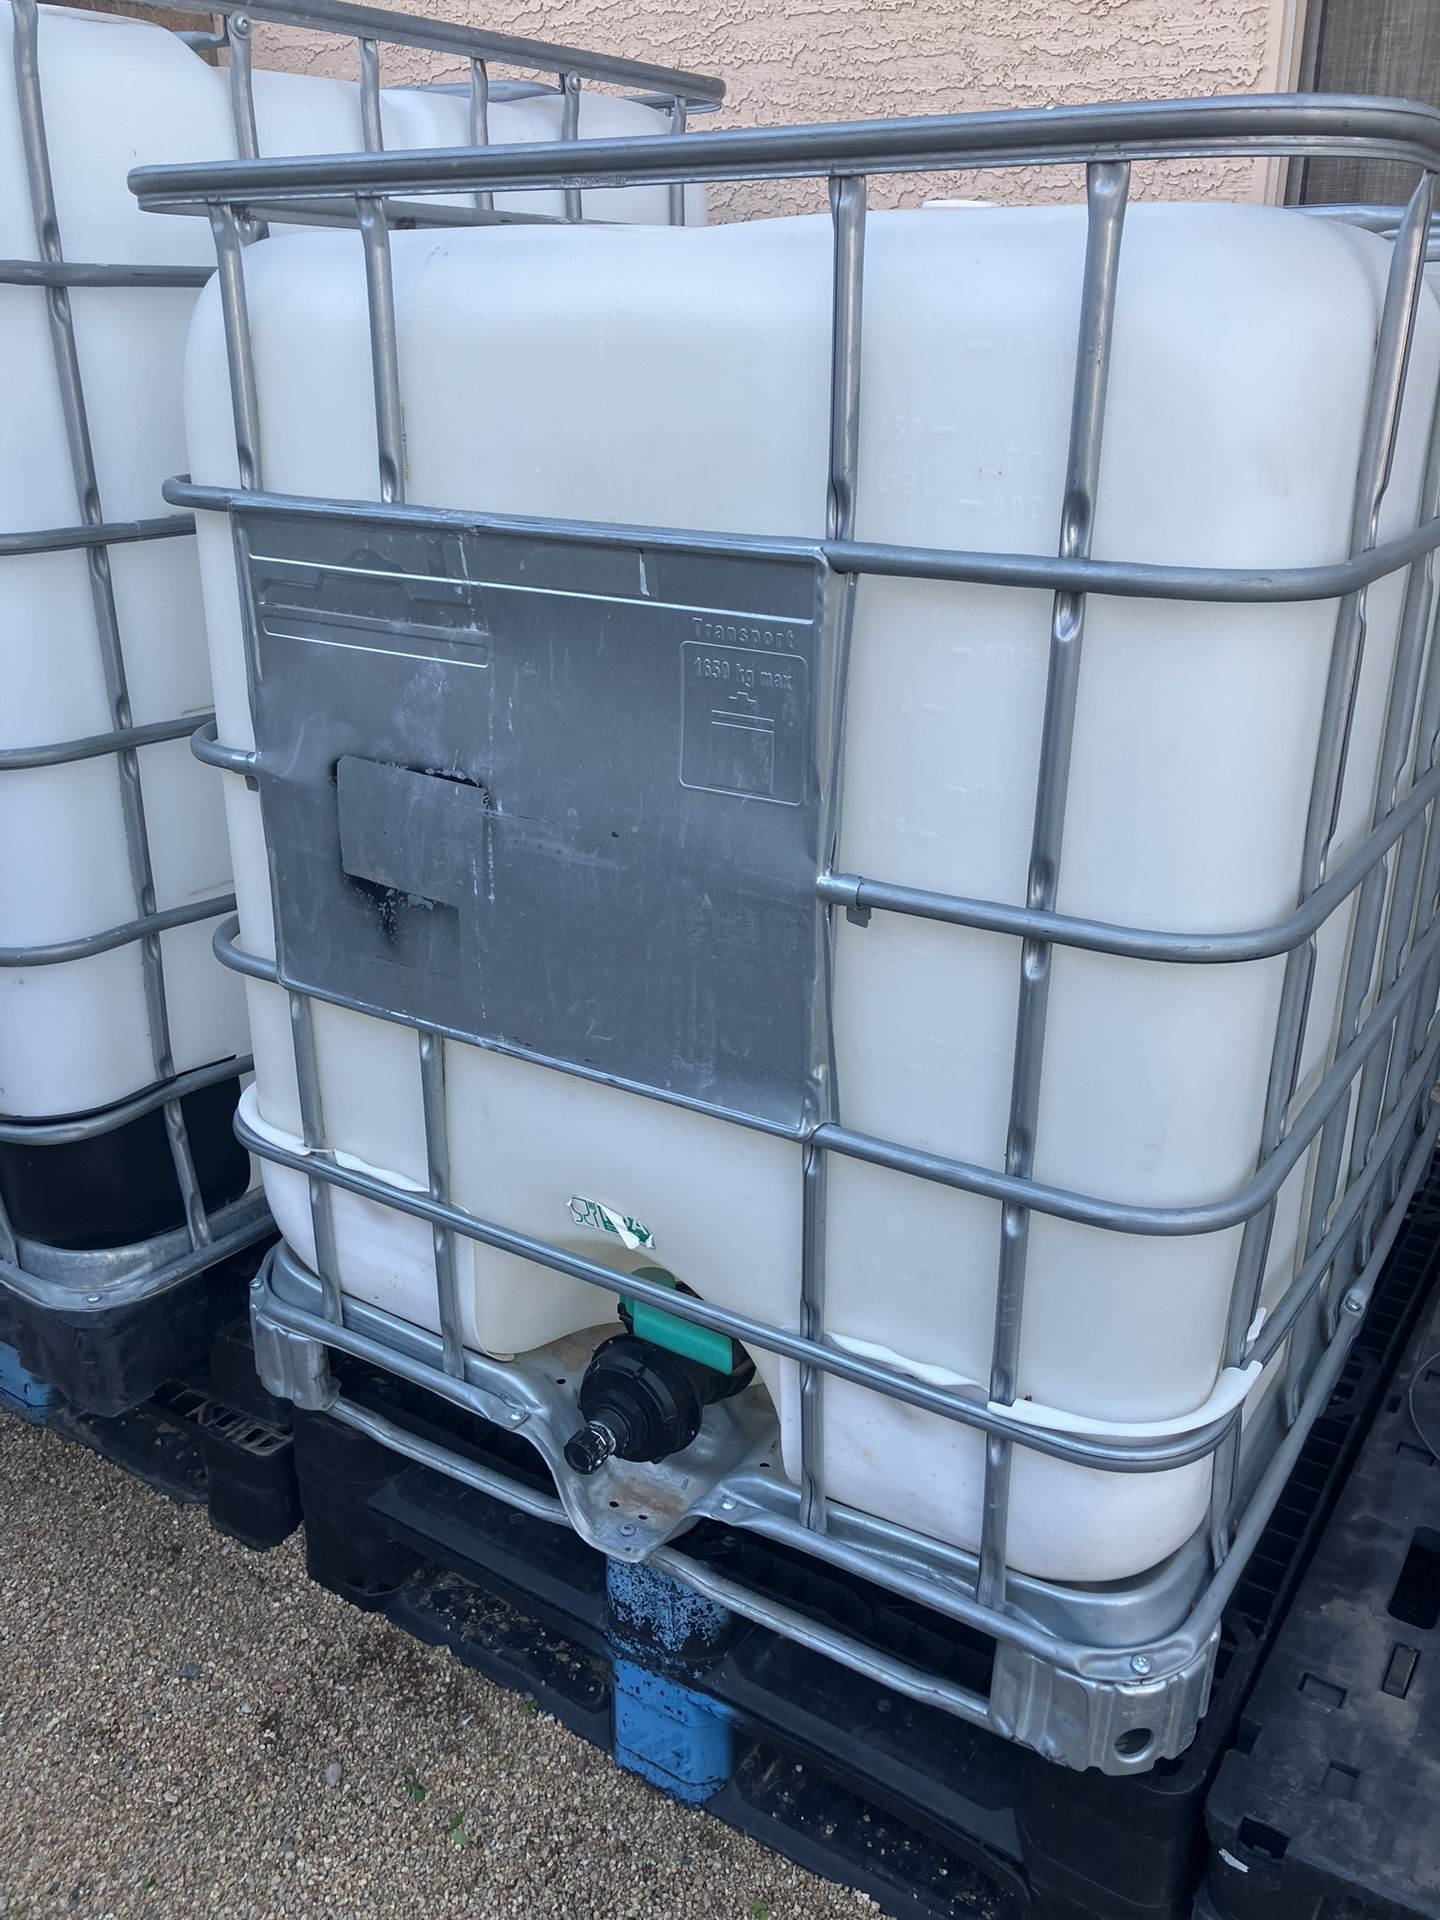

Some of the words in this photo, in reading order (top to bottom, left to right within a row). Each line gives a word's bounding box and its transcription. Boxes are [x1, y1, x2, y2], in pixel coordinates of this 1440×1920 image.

[877, 416, 924, 440] 250
[992, 493, 1045, 519] 900
[692, 617, 795, 649] Transport
[983, 642, 1033, 670] 800
[693, 656, 731, 680] 1650
[735, 662, 755, 688] kg
[760, 671, 793, 691] max
